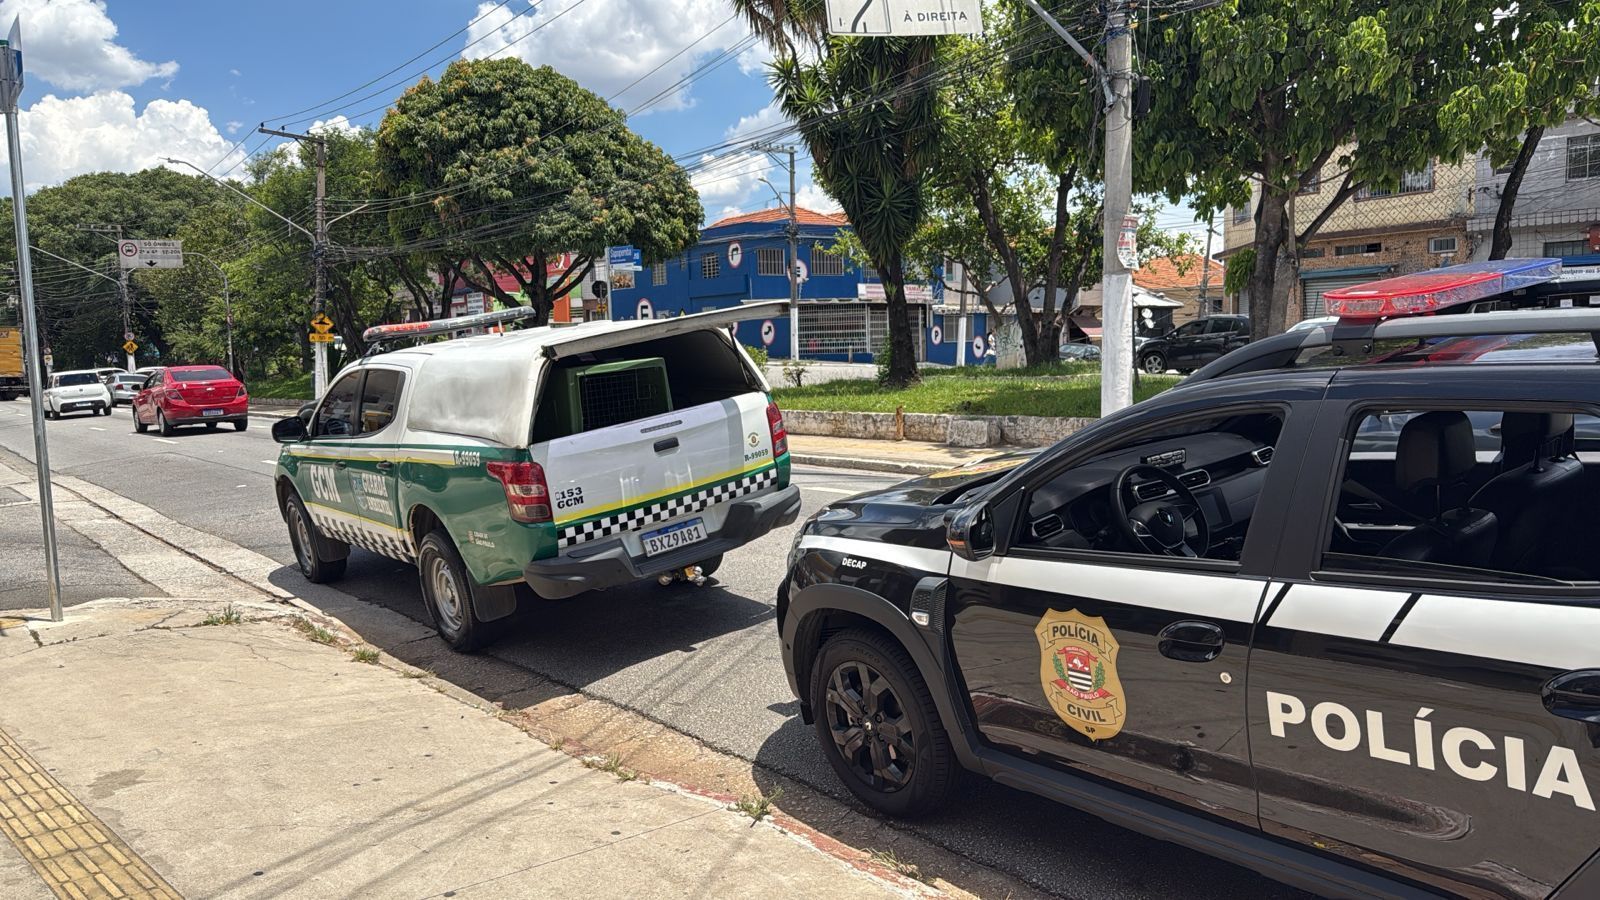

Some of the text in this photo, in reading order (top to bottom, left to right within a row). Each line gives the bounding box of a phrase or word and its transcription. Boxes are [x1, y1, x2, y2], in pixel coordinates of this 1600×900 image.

[903, 10, 968, 23] À DIREITA
[454, 450, 481, 468] R-99059
[744, 448, 769, 462] R-99059
[310, 464, 342, 503] GCM
[361, 472, 389, 498] GUARDA
[557, 495, 584, 509] GCM
[560, 486, 583, 500] 153
[649, 526, 702, 553] BXZ9A81
[842, 557, 867, 569] DECAP
[1052, 623, 1100, 647] POLÍCIA
[1067, 703, 1107, 723] CIVIL
[1084, 726, 1096, 735] SP
[1266, 690, 1597, 811] POLÍCIA
